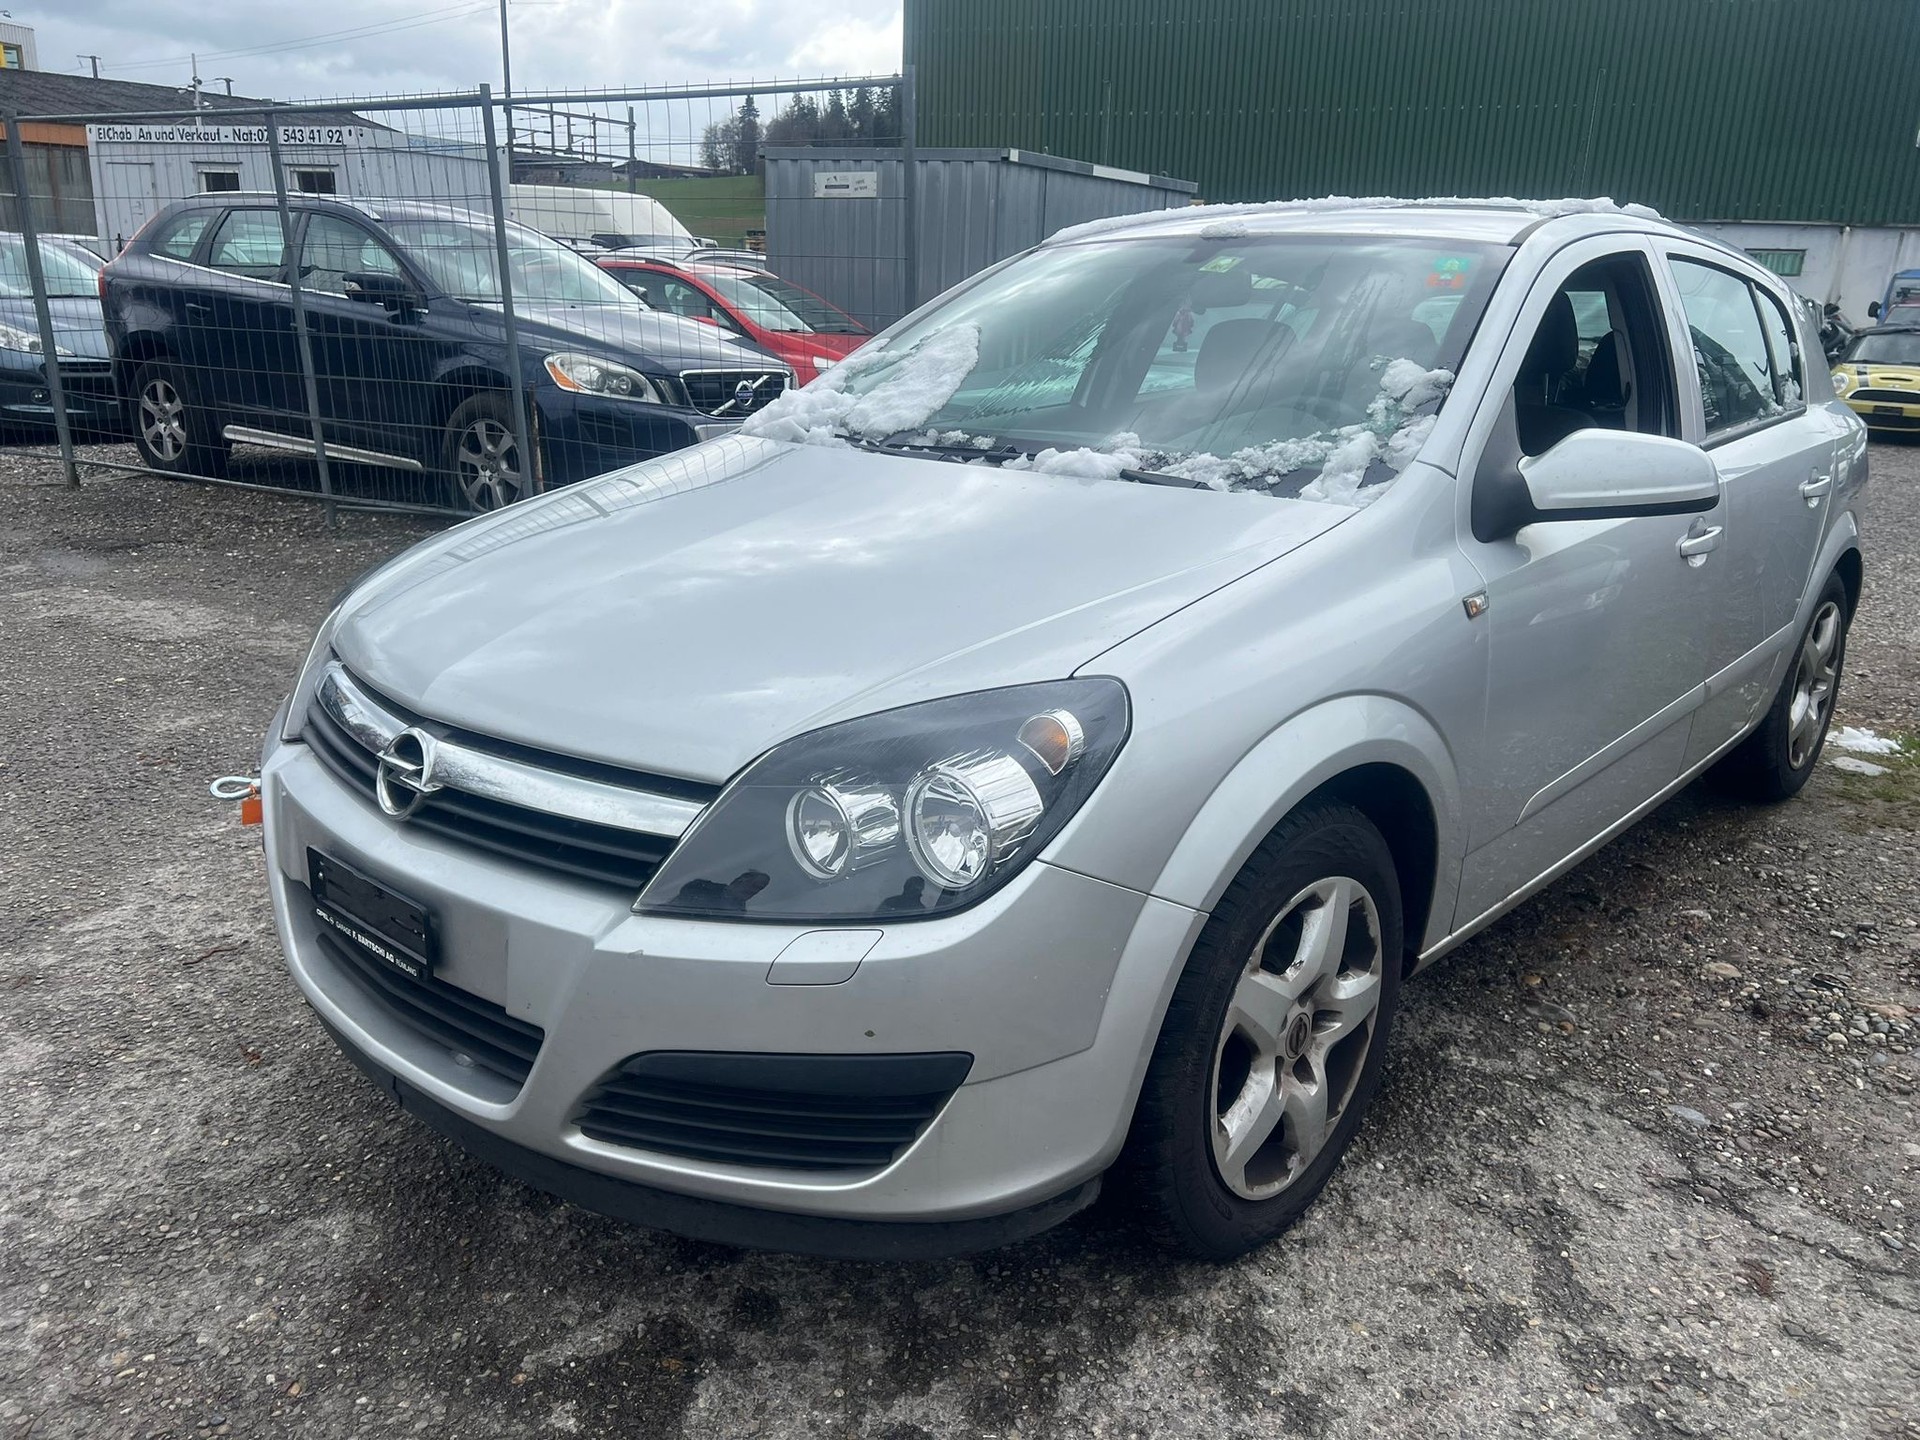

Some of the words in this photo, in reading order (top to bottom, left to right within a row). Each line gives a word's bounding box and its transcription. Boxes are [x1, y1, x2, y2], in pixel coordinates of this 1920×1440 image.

[138, 128, 152, 140] An
[155, 127, 174, 140] und
[177, 127, 220, 141] Verkauf
[283, 128, 305, 143] 543
[308, 129, 322, 143] 41
[327, 129, 342, 143] 92
